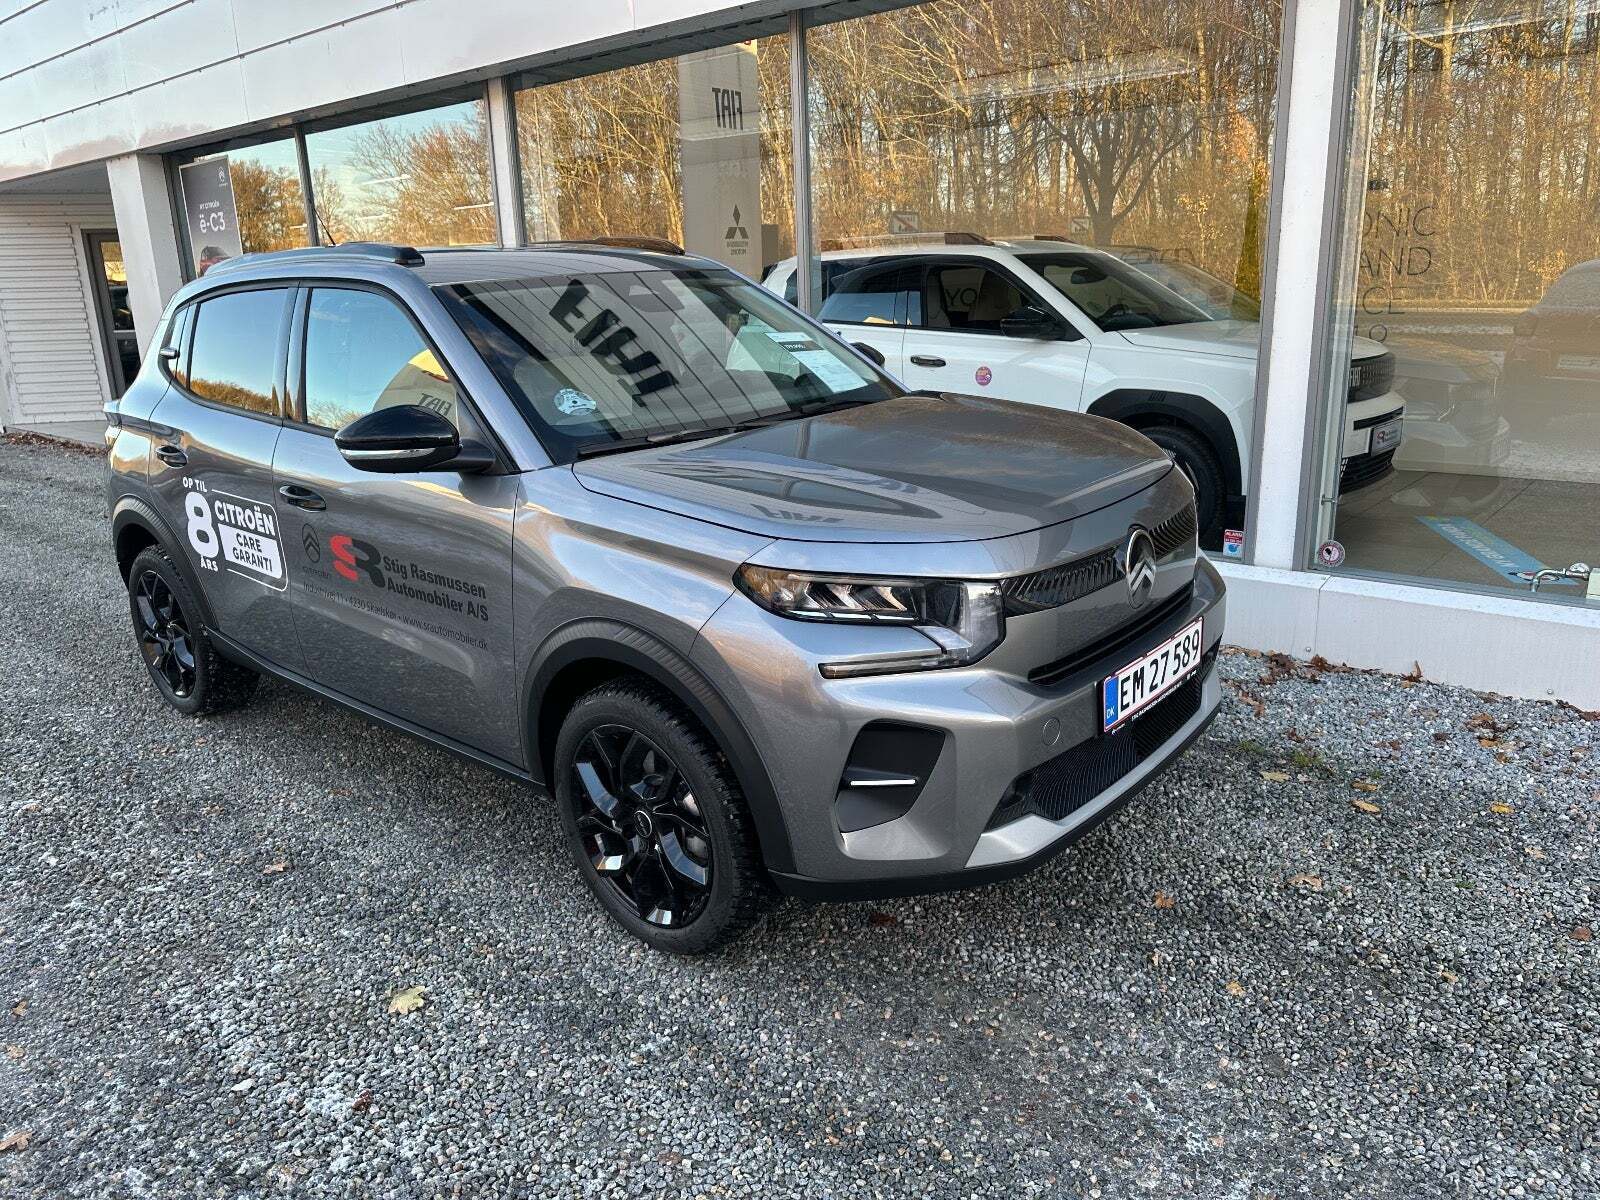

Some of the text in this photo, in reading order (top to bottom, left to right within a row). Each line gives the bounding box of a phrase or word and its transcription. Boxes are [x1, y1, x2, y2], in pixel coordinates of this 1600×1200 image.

[182, 476, 208, 493] OP TIL
[184, 491, 219, 559] 8
[214, 500, 276, 536] CITROËN
[232, 546, 273, 572] GARANTI
[236, 532, 262, 553] CARE
[382, 555, 486, 600] Stig Rasmussen
[387, 577, 489, 622] Automobiler A/S
[1120, 665, 1145, 712] EM
[1148, 649, 1170, 693] 27
[1172, 628, 1200, 676] 589
[1106, 705, 1115, 719] DK
